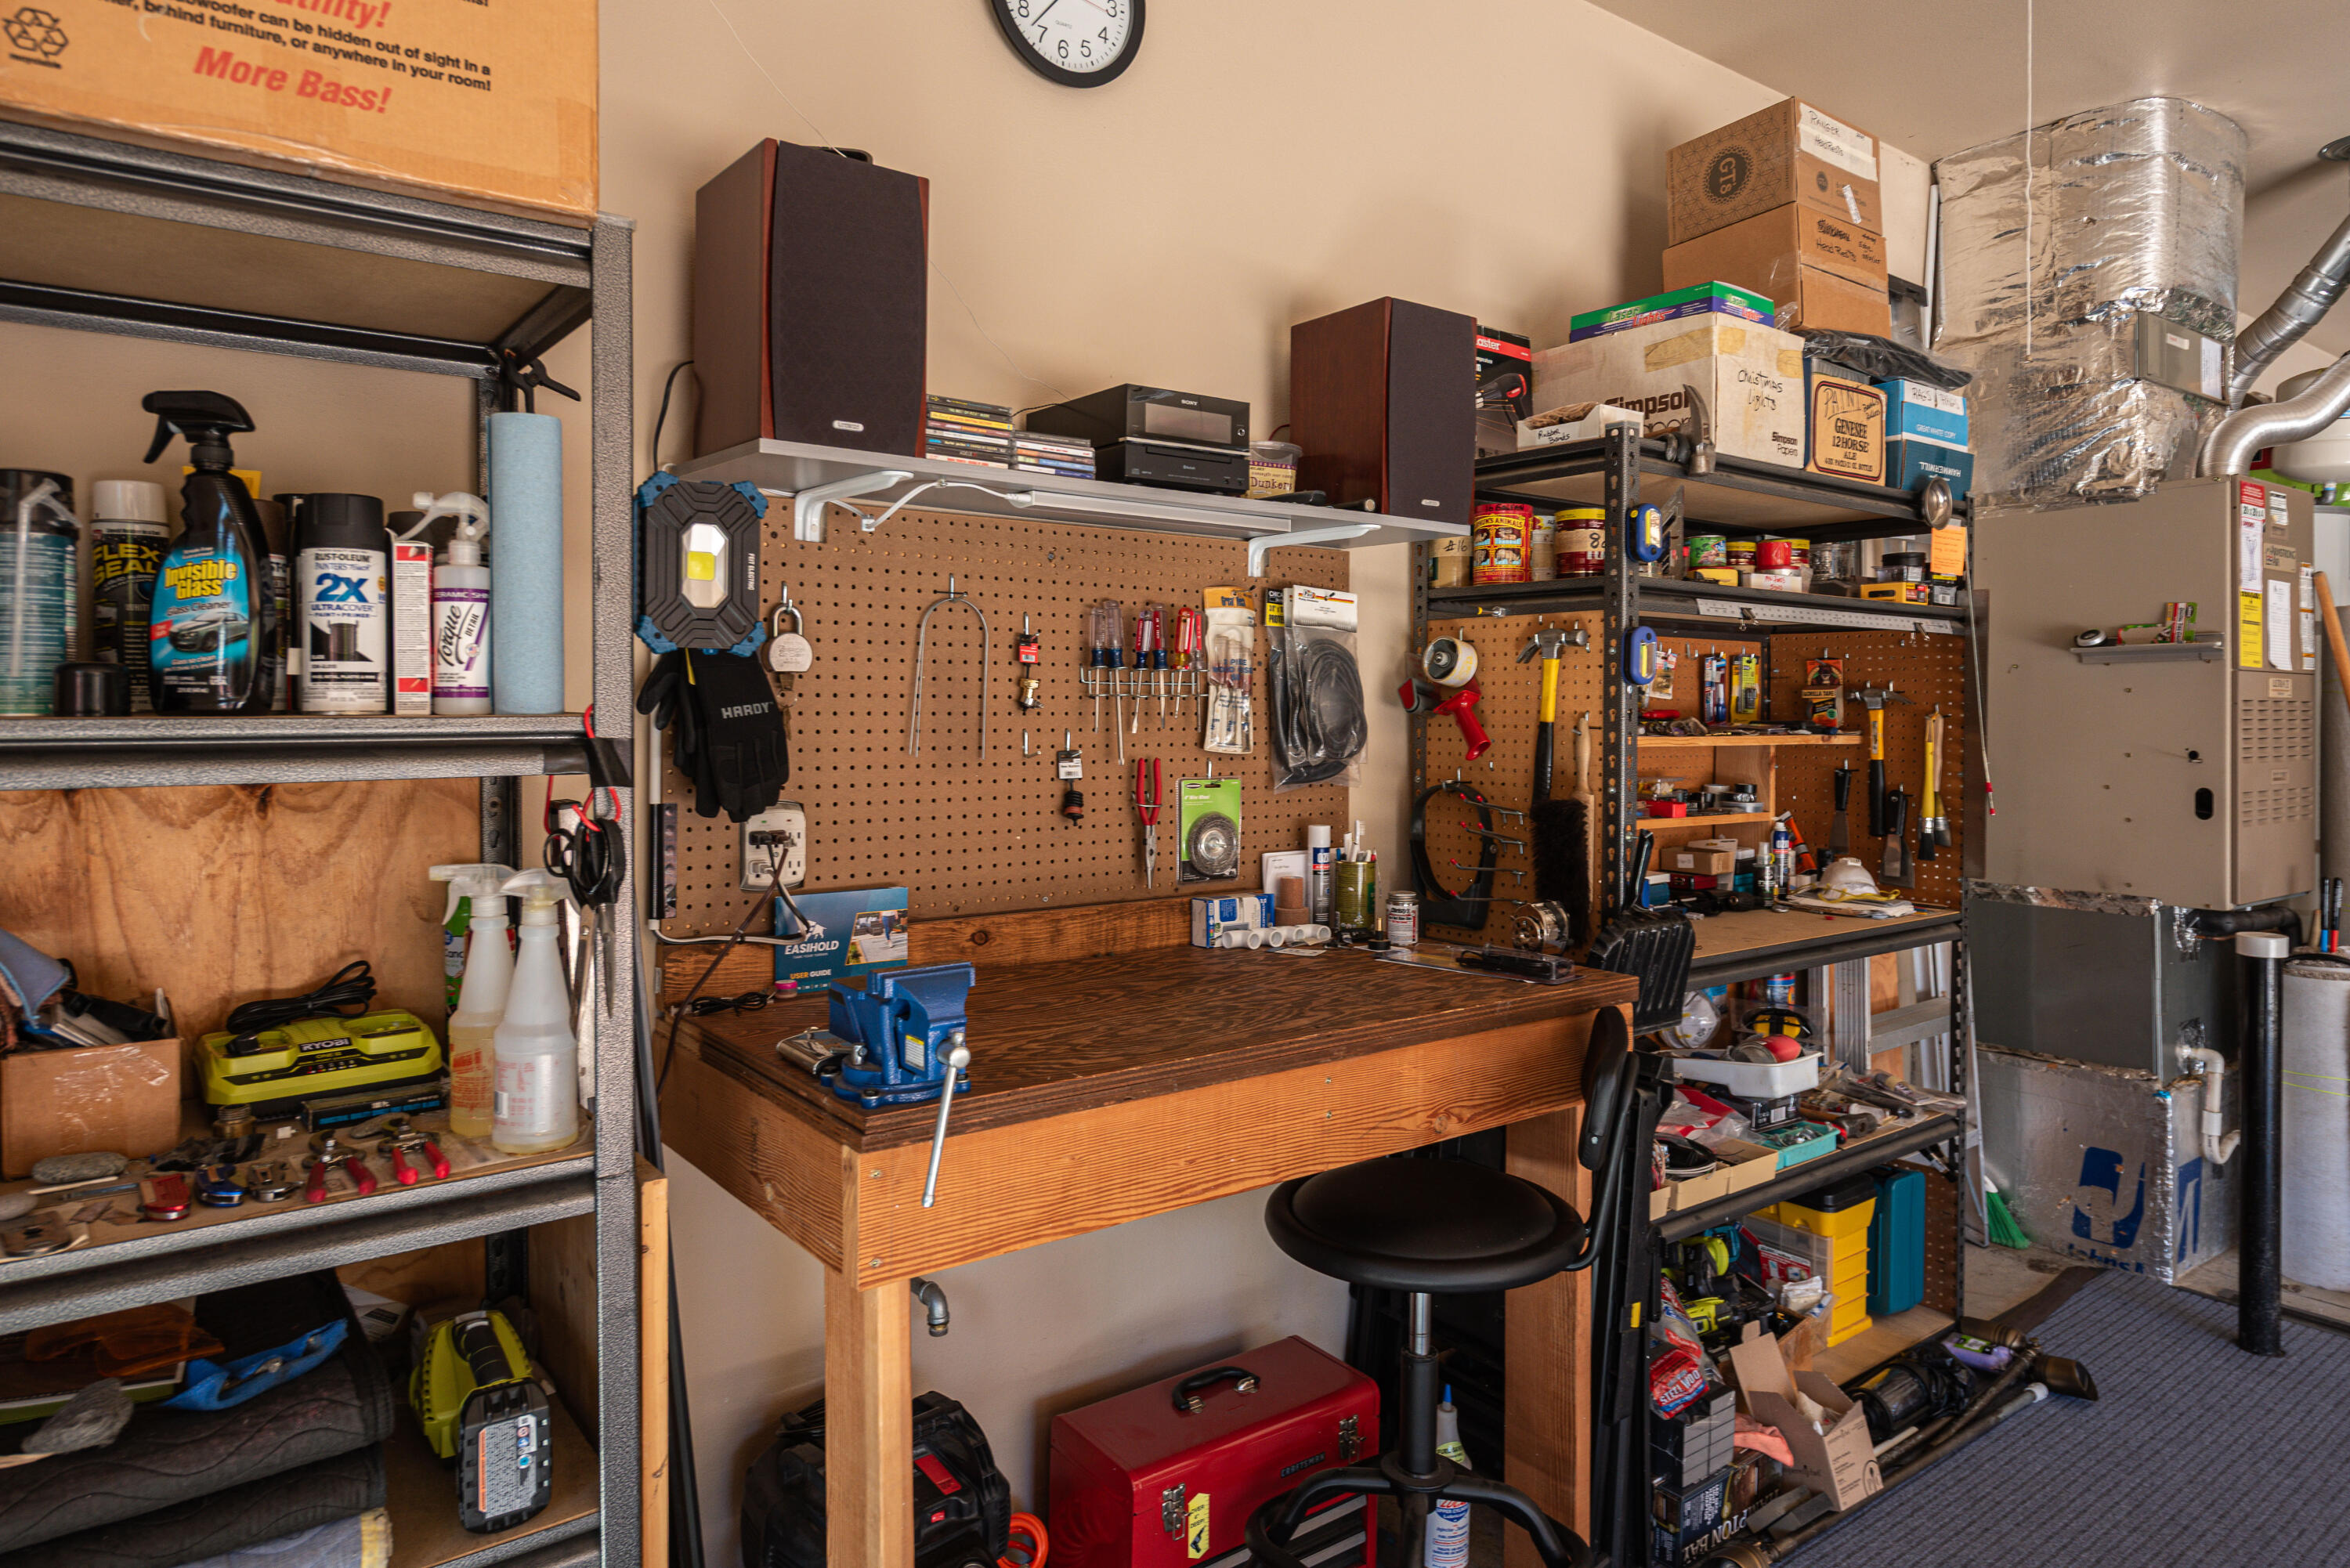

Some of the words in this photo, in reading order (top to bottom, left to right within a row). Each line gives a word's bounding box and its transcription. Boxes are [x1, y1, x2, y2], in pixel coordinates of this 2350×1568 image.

[1037, 24, 1048, 43] 7
[1097, 26, 1108, 44] 4
[144, 0, 204, 24] behind
[209, 16, 287, 47] furniture,
[290, 37, 309, 49] or
[313, 42, 389, 69] anywhere
[392, 59, 406, 73] in
[410, 63, 443, 81] your
[447, 73, 491, 92] room!
[258, 13, 289, 29] can
[293, 19, 313, 34] be
[317, 25, 371, 48] hidden
[375, 41, 400, 56] out
[404, 48, 420, 60] of
[424, 52, 461, 69] sight
[465, 59, 479, 73] in
[482, 66, 491, 76] a
[1058, 40, 1069, 59] 6
[1080, 40, 1091, 58] 5
[193, 45, 288, 92] More
[296, 69, 392, 114] Bass!
[1477, 336, 1501, 351] aster
[1835, 417, 1867, 439] GENESEE
[1251, 476, 1292, 490] Dunkers
[93, 542, 161, 564] FLEX
[315, 553, 371, 562] RUST-OLEUM
[94, 559, 157, 587] SEAL
[164, 558, 239, 589] Invisible
[176, 578, 223, 600] Glass
[316, 573, 370, 603] 2X
[721, 703, 772, 719] HARDY
[784, 941, 840, 955] EASIHOLD
[809, 969, 832, 977] GUIDE
[301, 1038, 351, 1052] RYOBI
[1680, 1370, 1701, 1389] WOO
